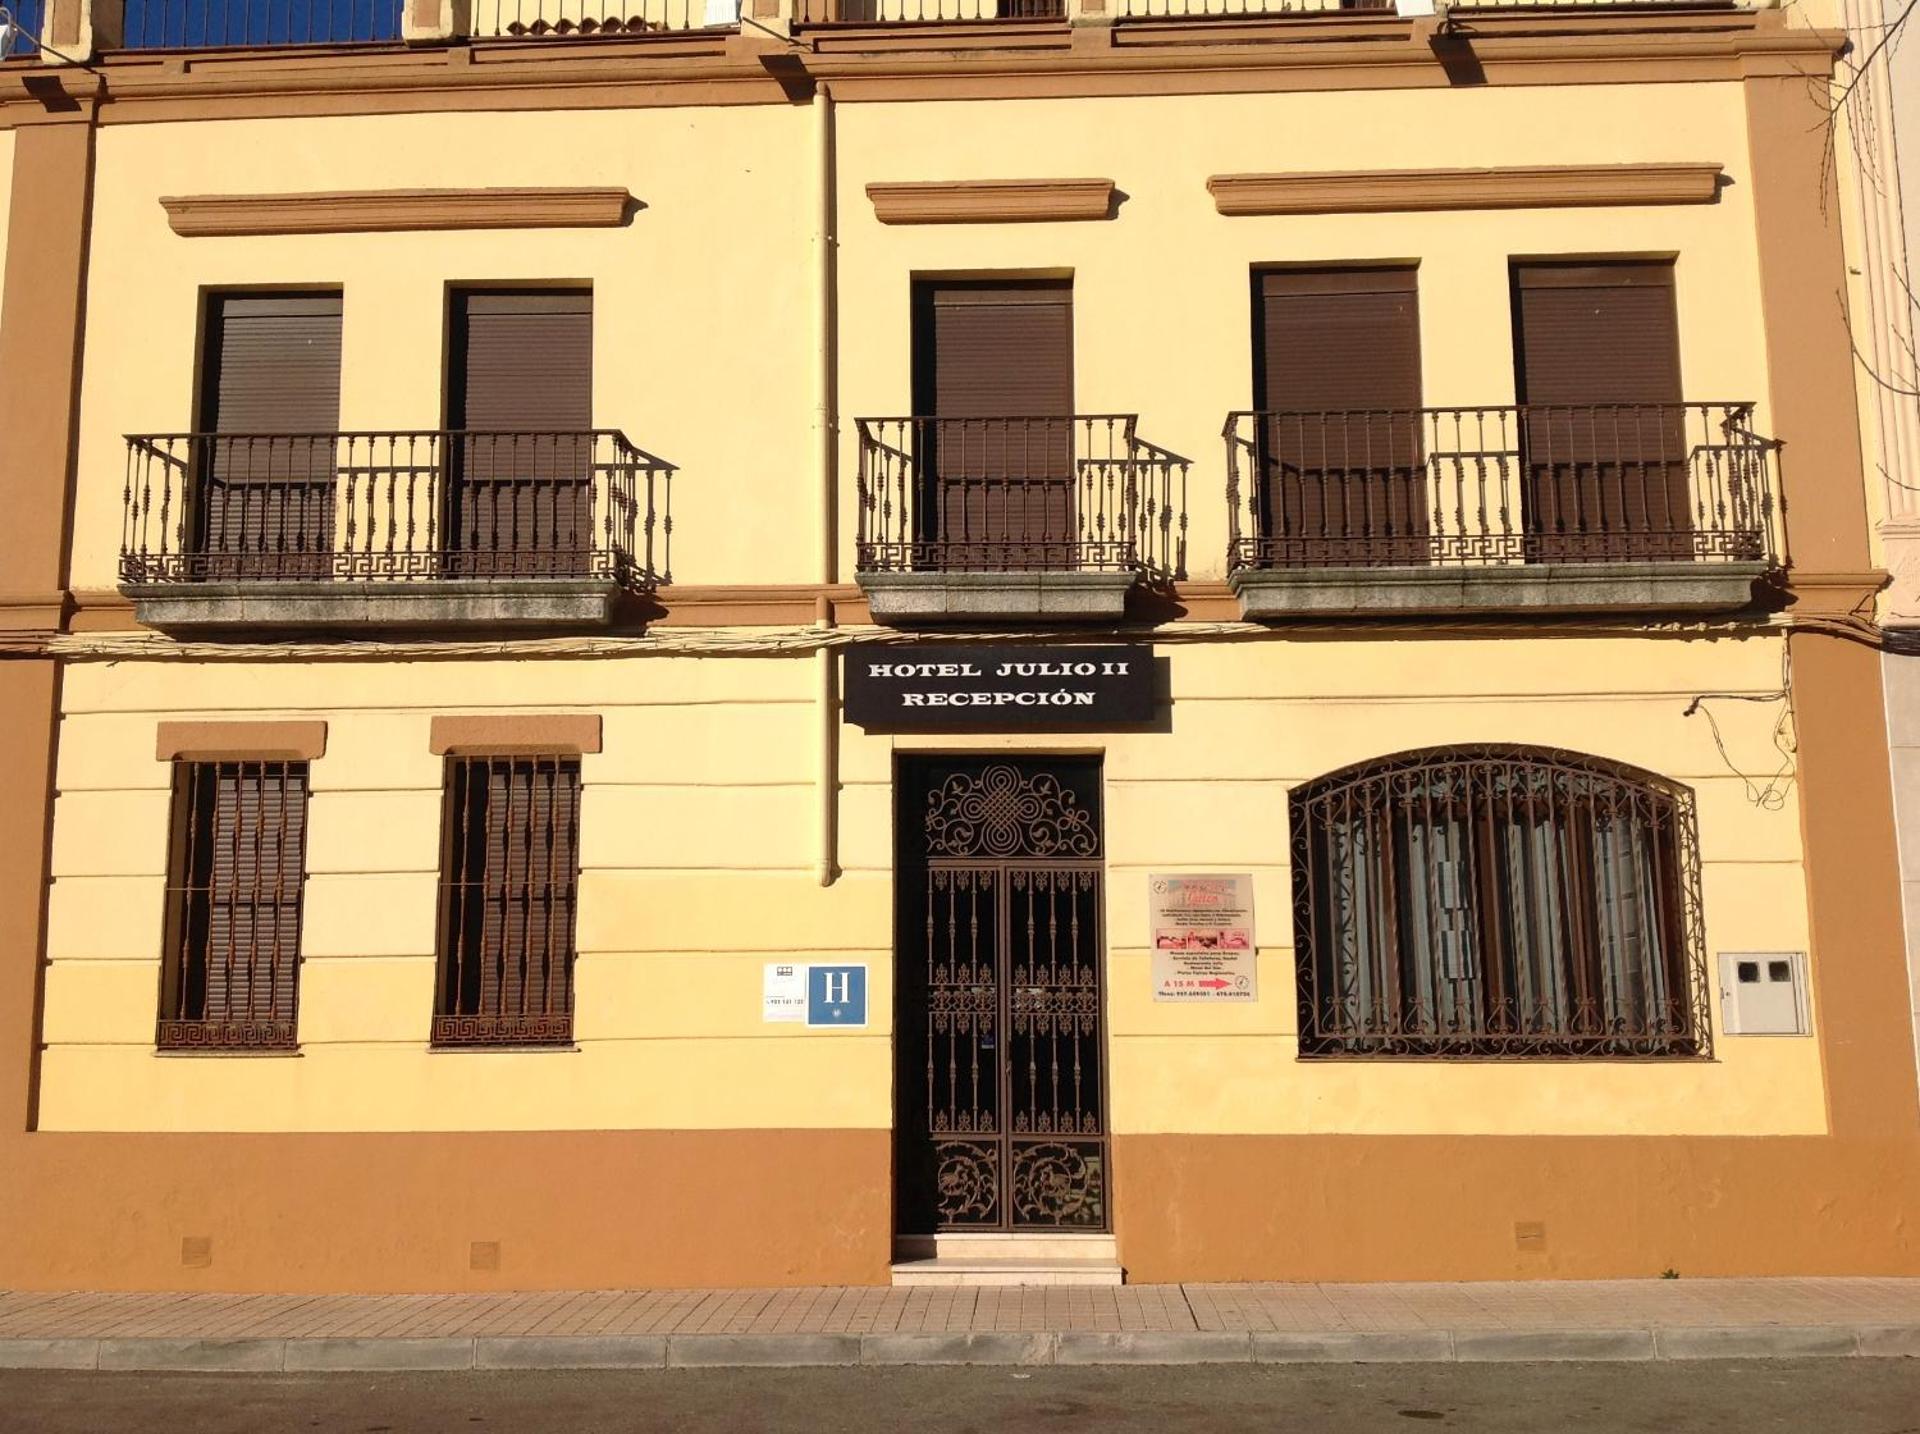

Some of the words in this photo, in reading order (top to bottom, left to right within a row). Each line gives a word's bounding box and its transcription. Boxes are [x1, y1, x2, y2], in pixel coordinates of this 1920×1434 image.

[868, 663, 982, 677] HOTEL
[996, 662, 1097, 676] JULIO
[1101, 662, 1129, 676] II
[901, 688, 1096, 706] RECEPCIÓN
[823, 972, 850, 1004] H
